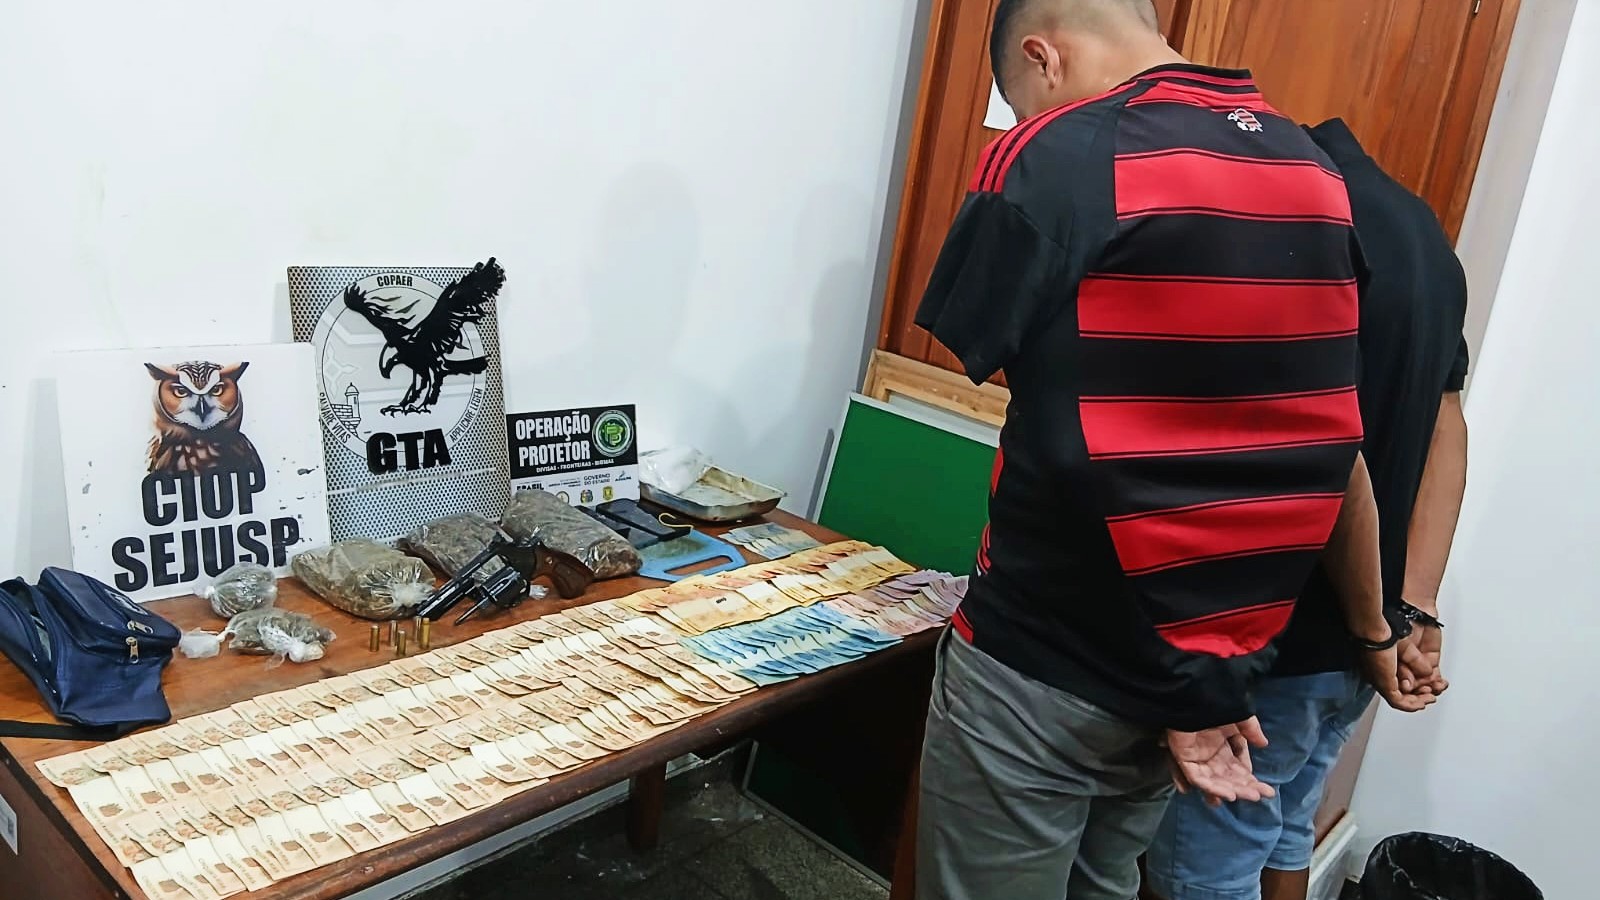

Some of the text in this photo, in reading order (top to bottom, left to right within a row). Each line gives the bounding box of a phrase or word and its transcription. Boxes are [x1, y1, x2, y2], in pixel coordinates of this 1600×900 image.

[377, 274, 413, 287] COPAER
[332, 422, 351, 444] VITAS
[450, 387, 483, 442] APPLICARE LEGEM
[515, 411, 591, 441] OPERAÇÃO
[366, 428, 452, 476] GTA
[518, 440, 591, 467] PROTETOR
[141, 467, 266, 527] CIOP
[112, 517, 300, 593] SEJUSP
